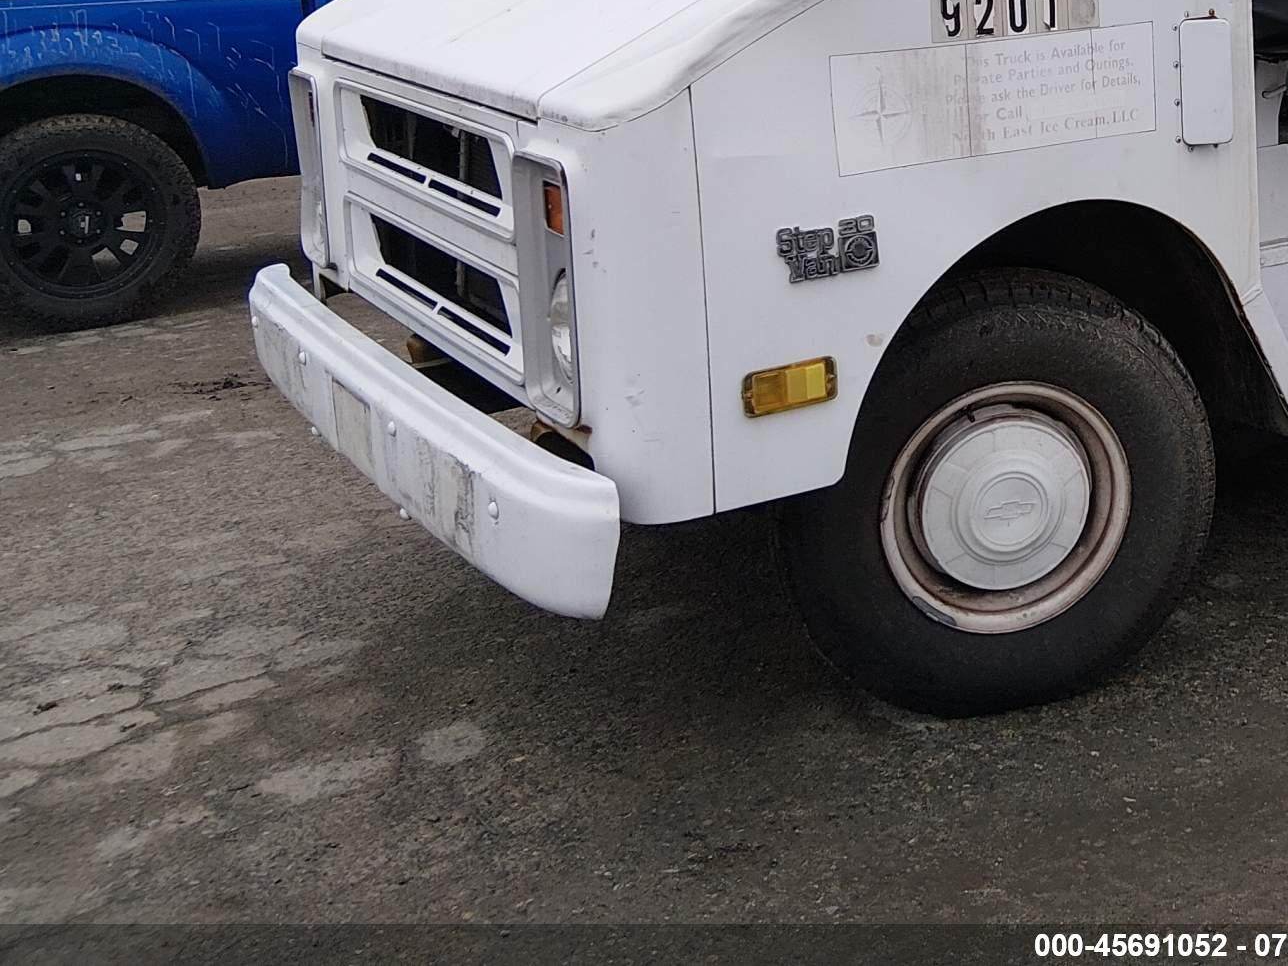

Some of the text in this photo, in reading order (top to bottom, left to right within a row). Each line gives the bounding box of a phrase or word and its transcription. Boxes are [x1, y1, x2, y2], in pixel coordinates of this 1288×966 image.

[994, 49, 1031, 66] Truck
[1051, 41, 1104, 59] Available
[1109, 38, 1126, 53] for
[1058, 60, 1080, 76] and
[992, 88, 1010, 103] ask
[1016, 86, 1036, 99] the
[1040, 80, 1076, 96] Driver
[776, 225, 835, 257] Step
[784, 253, 842, 284] Van
